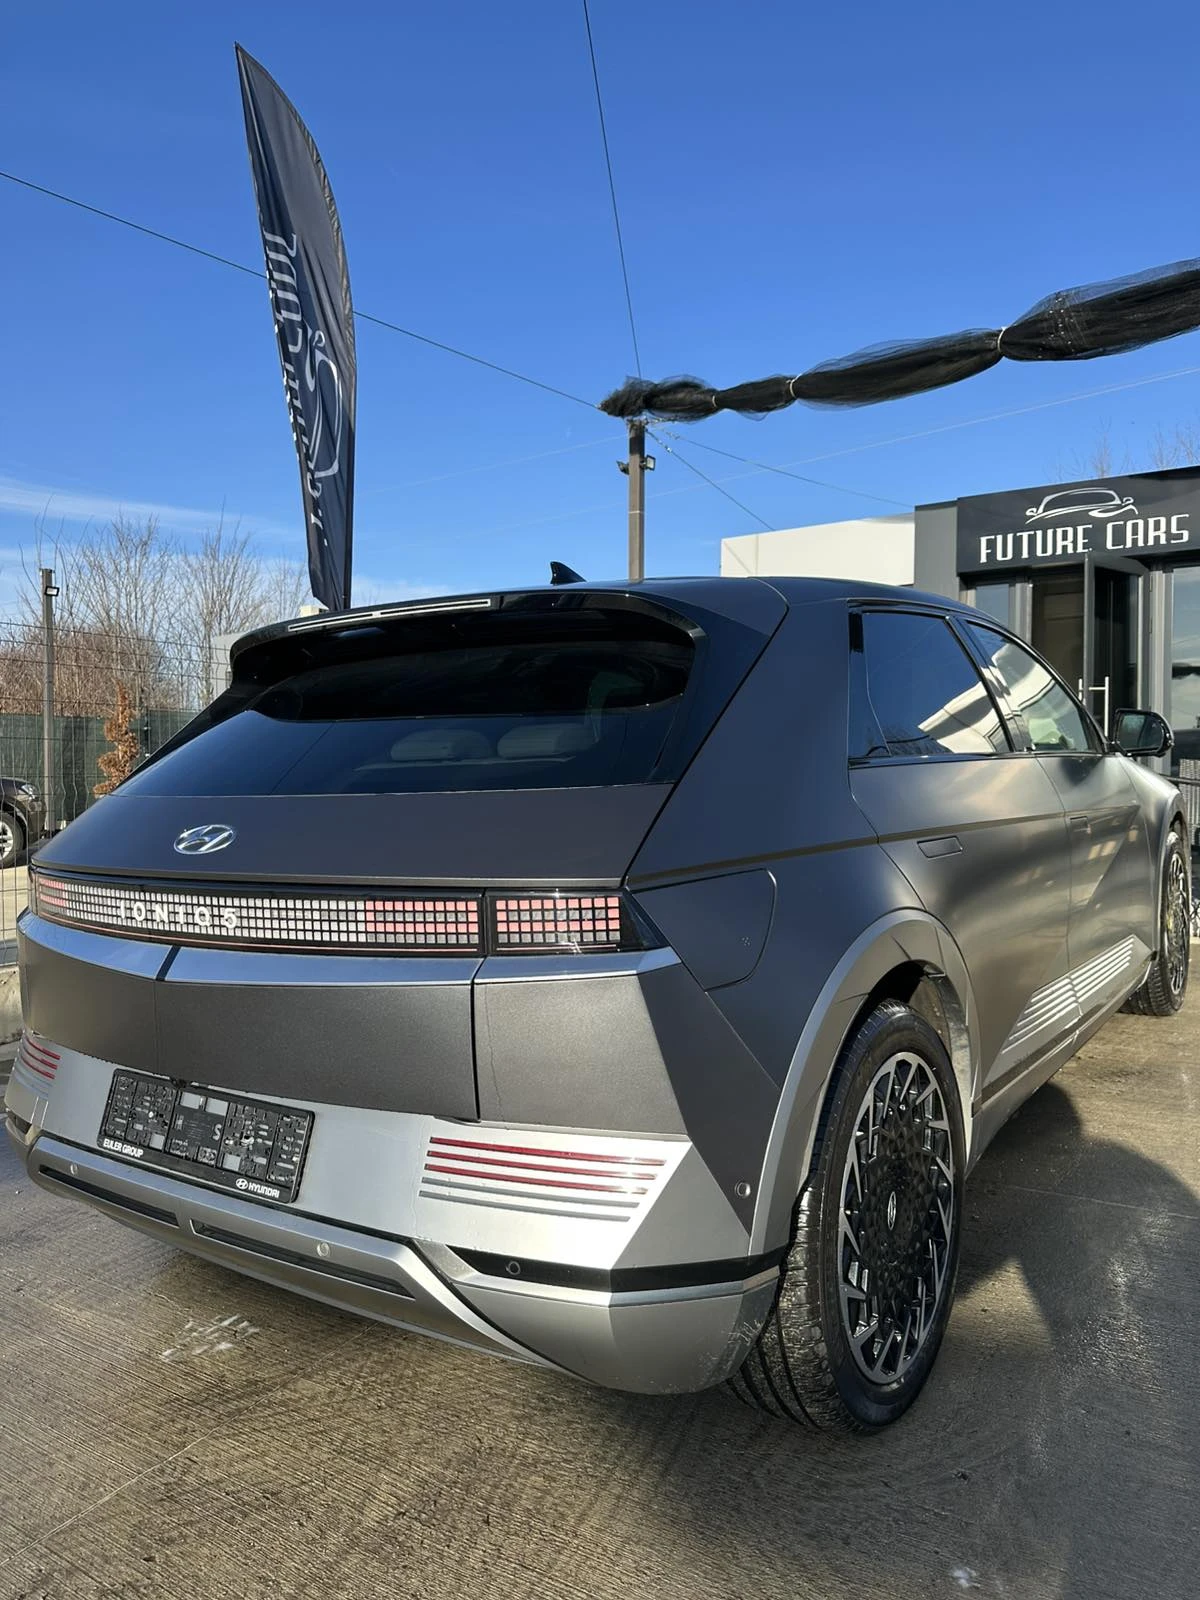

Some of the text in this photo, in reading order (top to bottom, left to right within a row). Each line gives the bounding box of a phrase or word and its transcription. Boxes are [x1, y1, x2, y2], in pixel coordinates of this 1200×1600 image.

[979, 513, 1190, 563] FUTURE CARS
[103, 1138, 144, 1159] EULER GROUP
[248, 1181, 281, 1199] HYUNDAI
